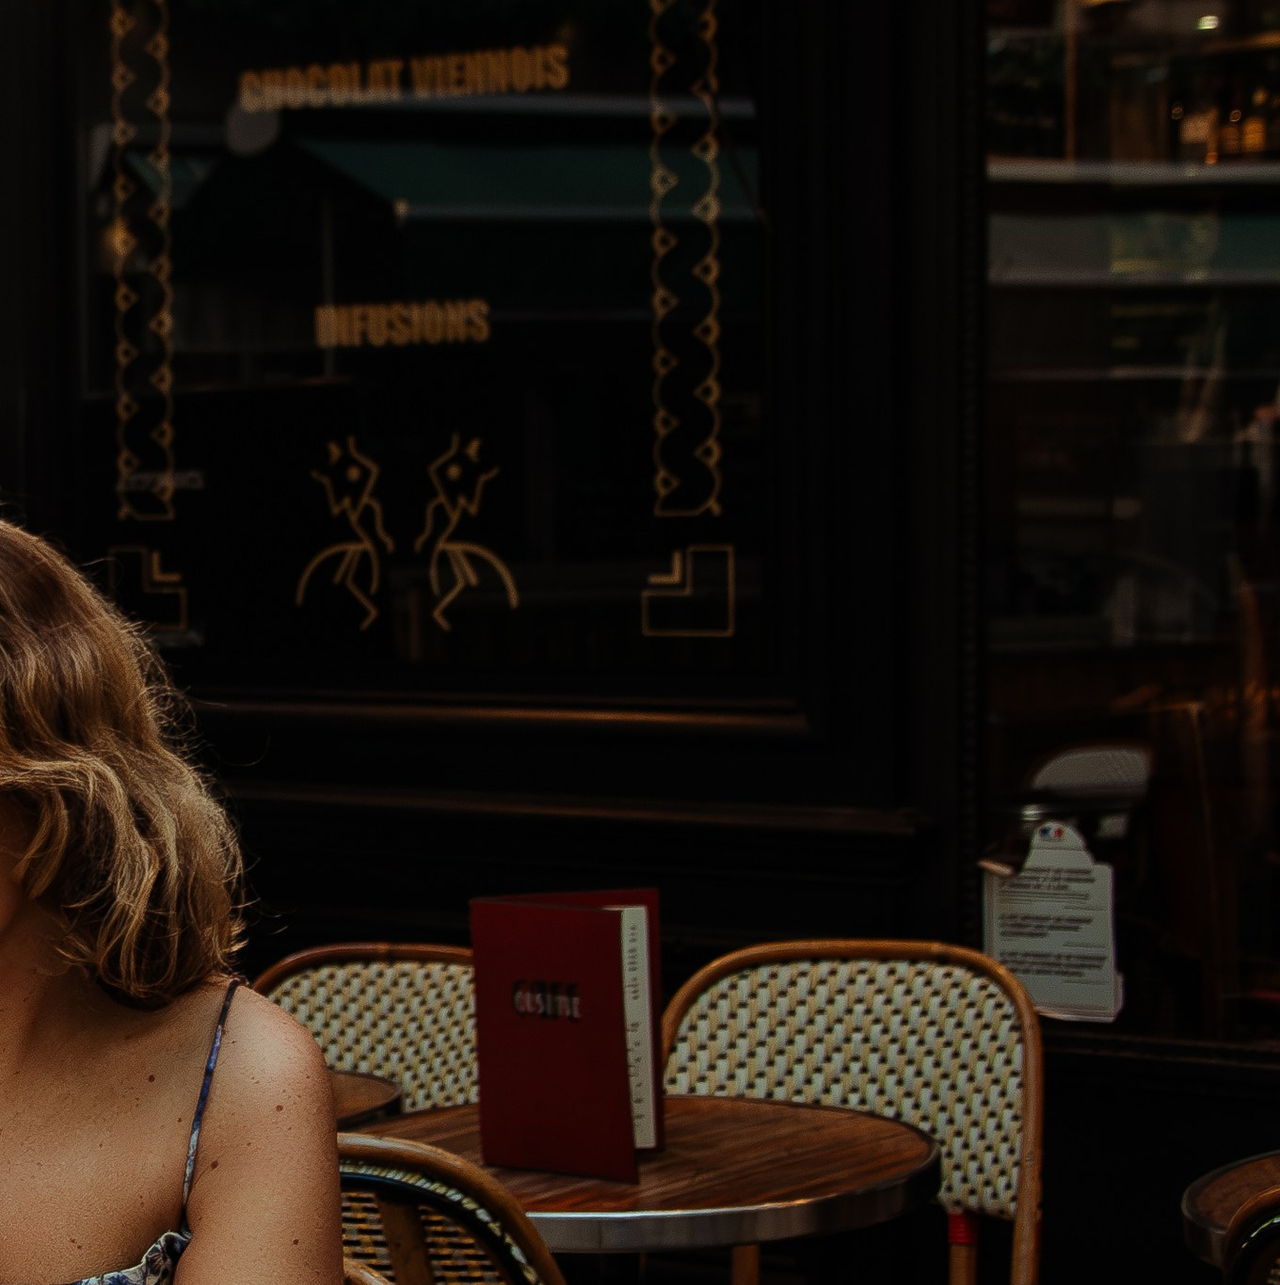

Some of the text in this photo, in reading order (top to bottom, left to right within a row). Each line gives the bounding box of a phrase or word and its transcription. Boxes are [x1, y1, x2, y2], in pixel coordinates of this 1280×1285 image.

[238, 42, 571, 113] CHOCOLAT VIENNOIS
[314, 298, 491, 349] INFUSIONS
